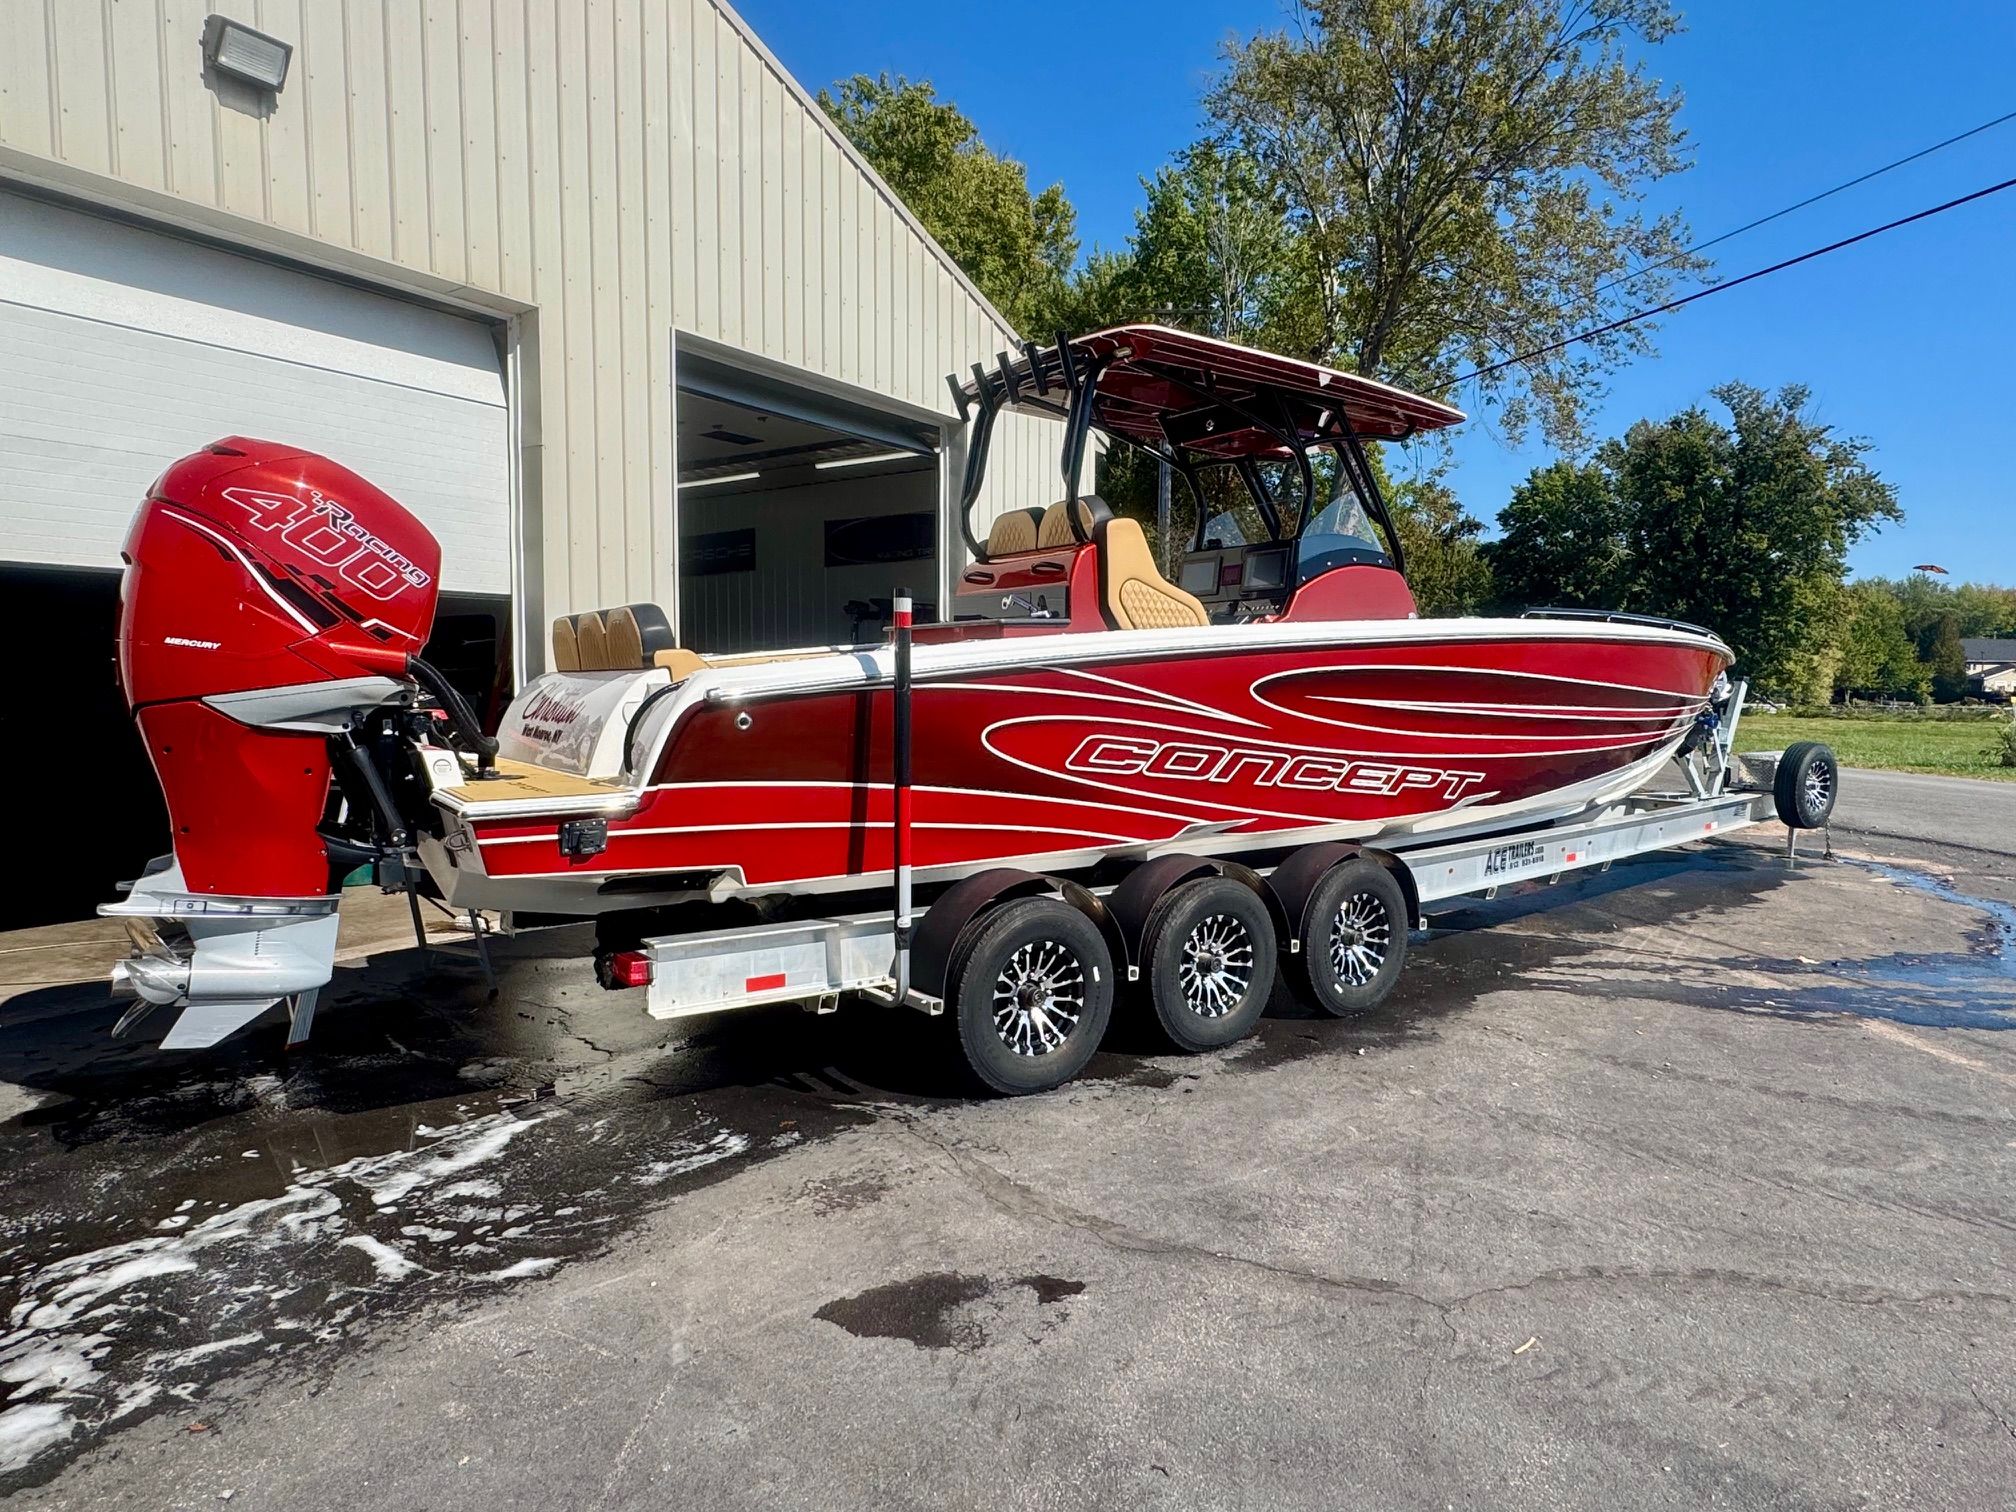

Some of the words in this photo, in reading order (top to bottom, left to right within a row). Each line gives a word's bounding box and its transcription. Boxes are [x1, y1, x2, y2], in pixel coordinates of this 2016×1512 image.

[221, 486, 410, 600] 400
[313, 496, 431, 589] Racing
[164, 636, 222, 650] MERCURY
[1065, 733, 1487, 800] CONCEPT
[1484, 847, 1507, 876] ACE
